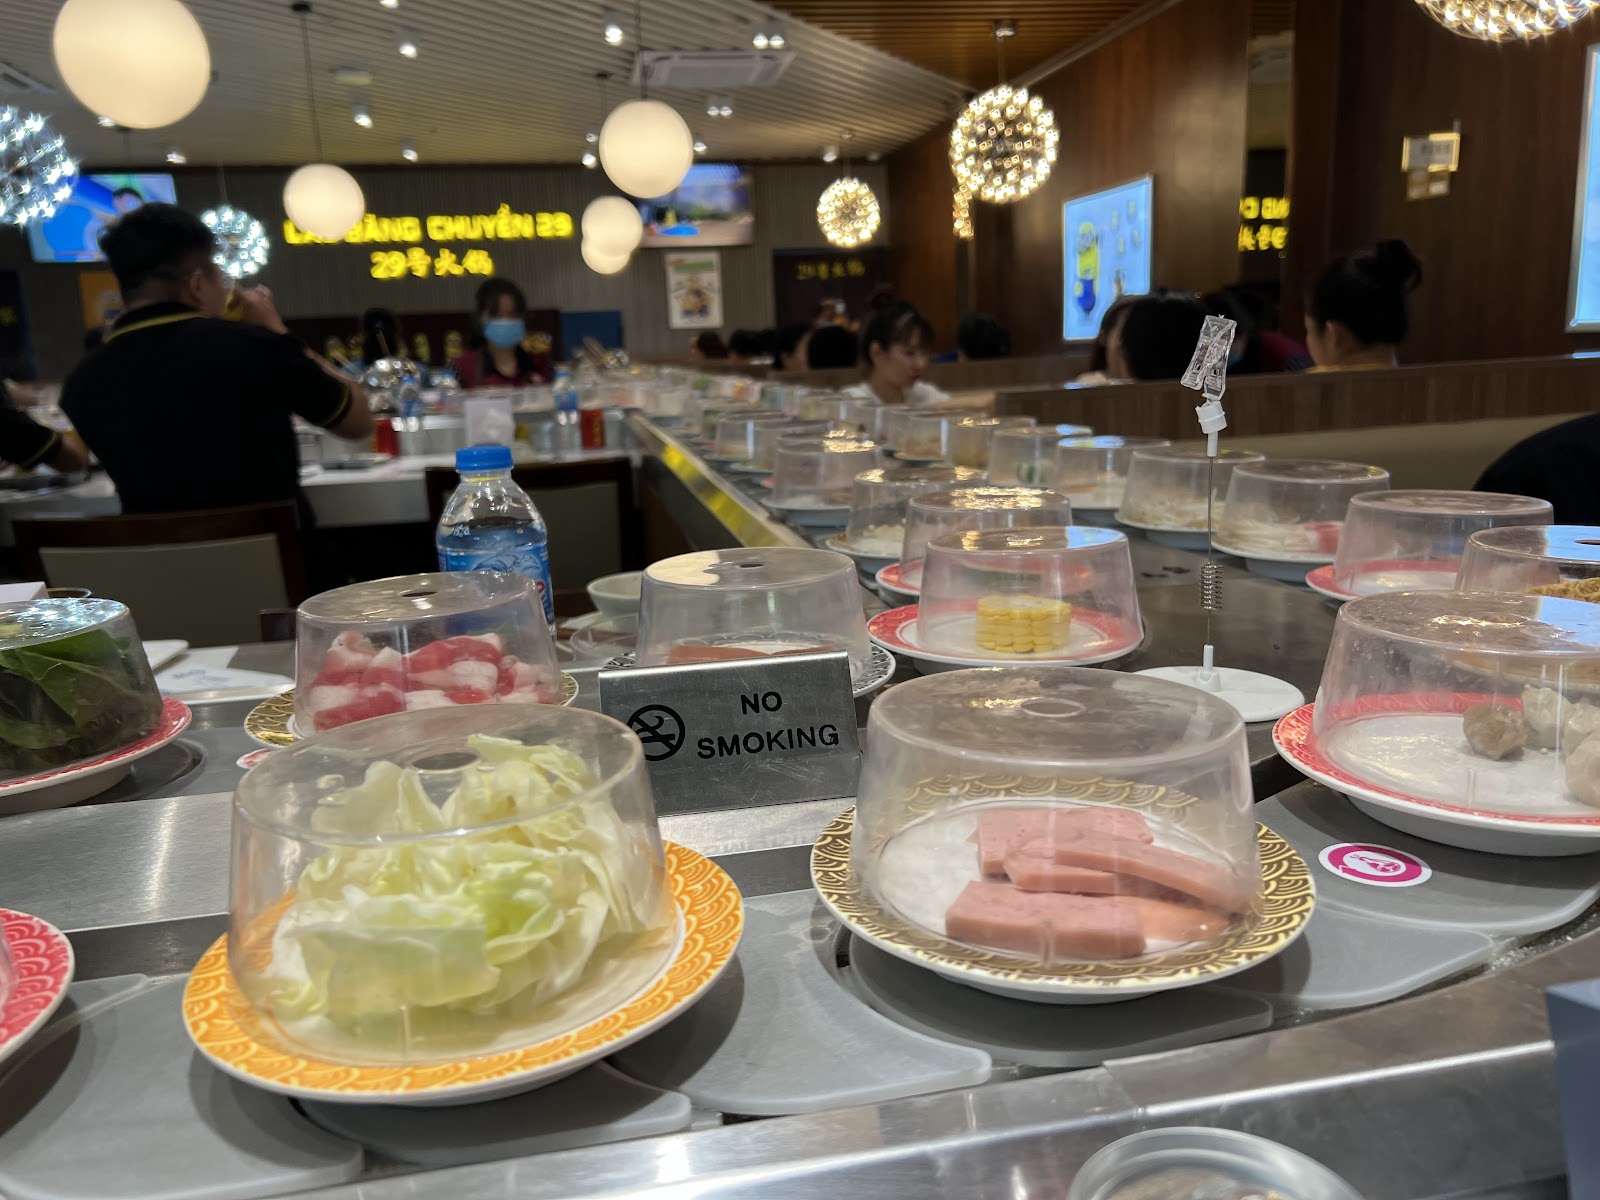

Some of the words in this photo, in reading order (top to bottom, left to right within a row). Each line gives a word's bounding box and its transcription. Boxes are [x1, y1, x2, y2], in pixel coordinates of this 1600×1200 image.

[536, 212, 572, 238] 29
[740, 691, 783, 715] NO
[697, 724, 840, 759] SMOKING
